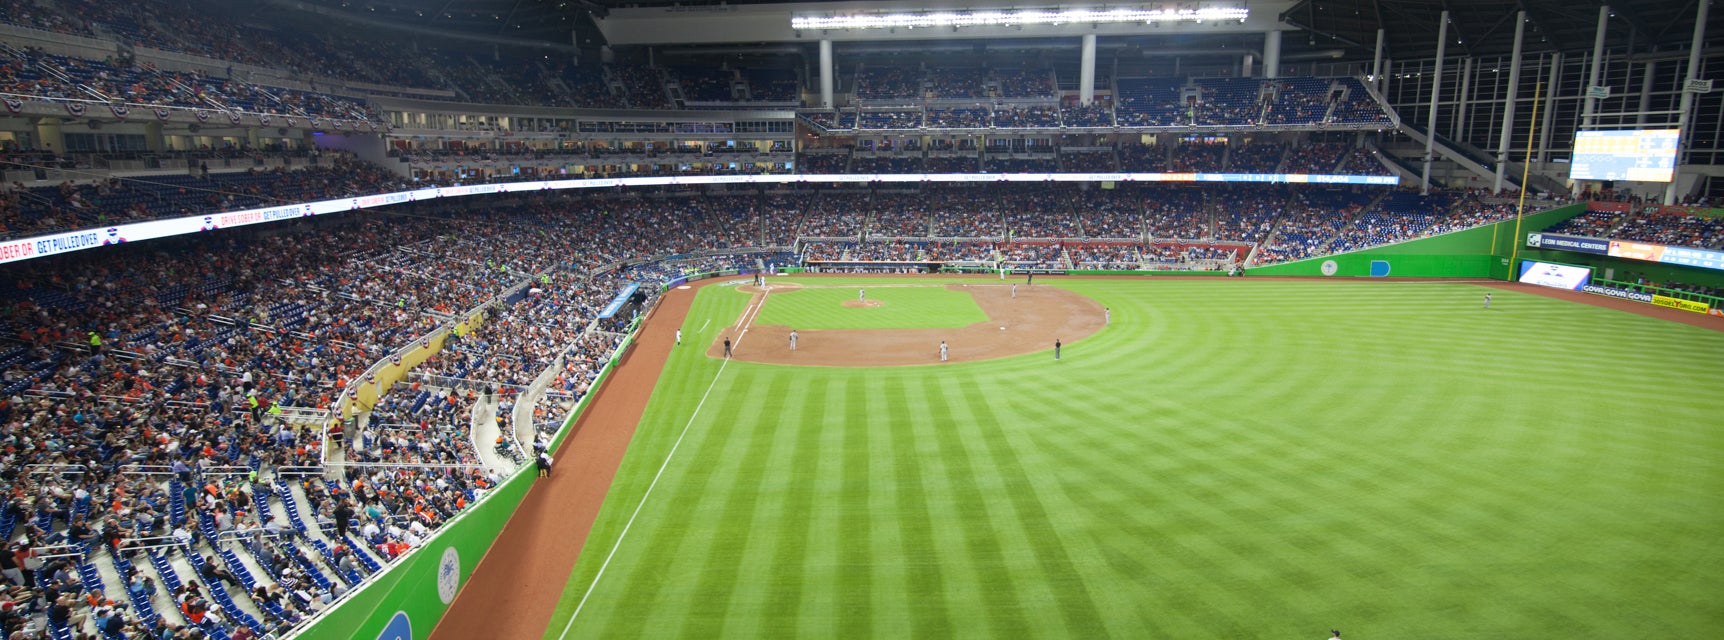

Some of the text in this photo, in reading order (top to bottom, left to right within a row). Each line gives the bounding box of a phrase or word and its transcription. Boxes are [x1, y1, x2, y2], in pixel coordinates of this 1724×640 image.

[22, 242, 33, 256] OR
[37, 240, 52, 254] GET
[53, 235, 80, 251] PULLED
[80, 233, 98, 246] OVER
[1556, 240, 1580, 248] MEDICAL
[1581, 242, 1607, 250] CENTERS
[1583, 285, 1604, 294] GOYA
[1605, 288, 1627, 297] GOYA
[1628, 292, 1651, 302] GOYA
